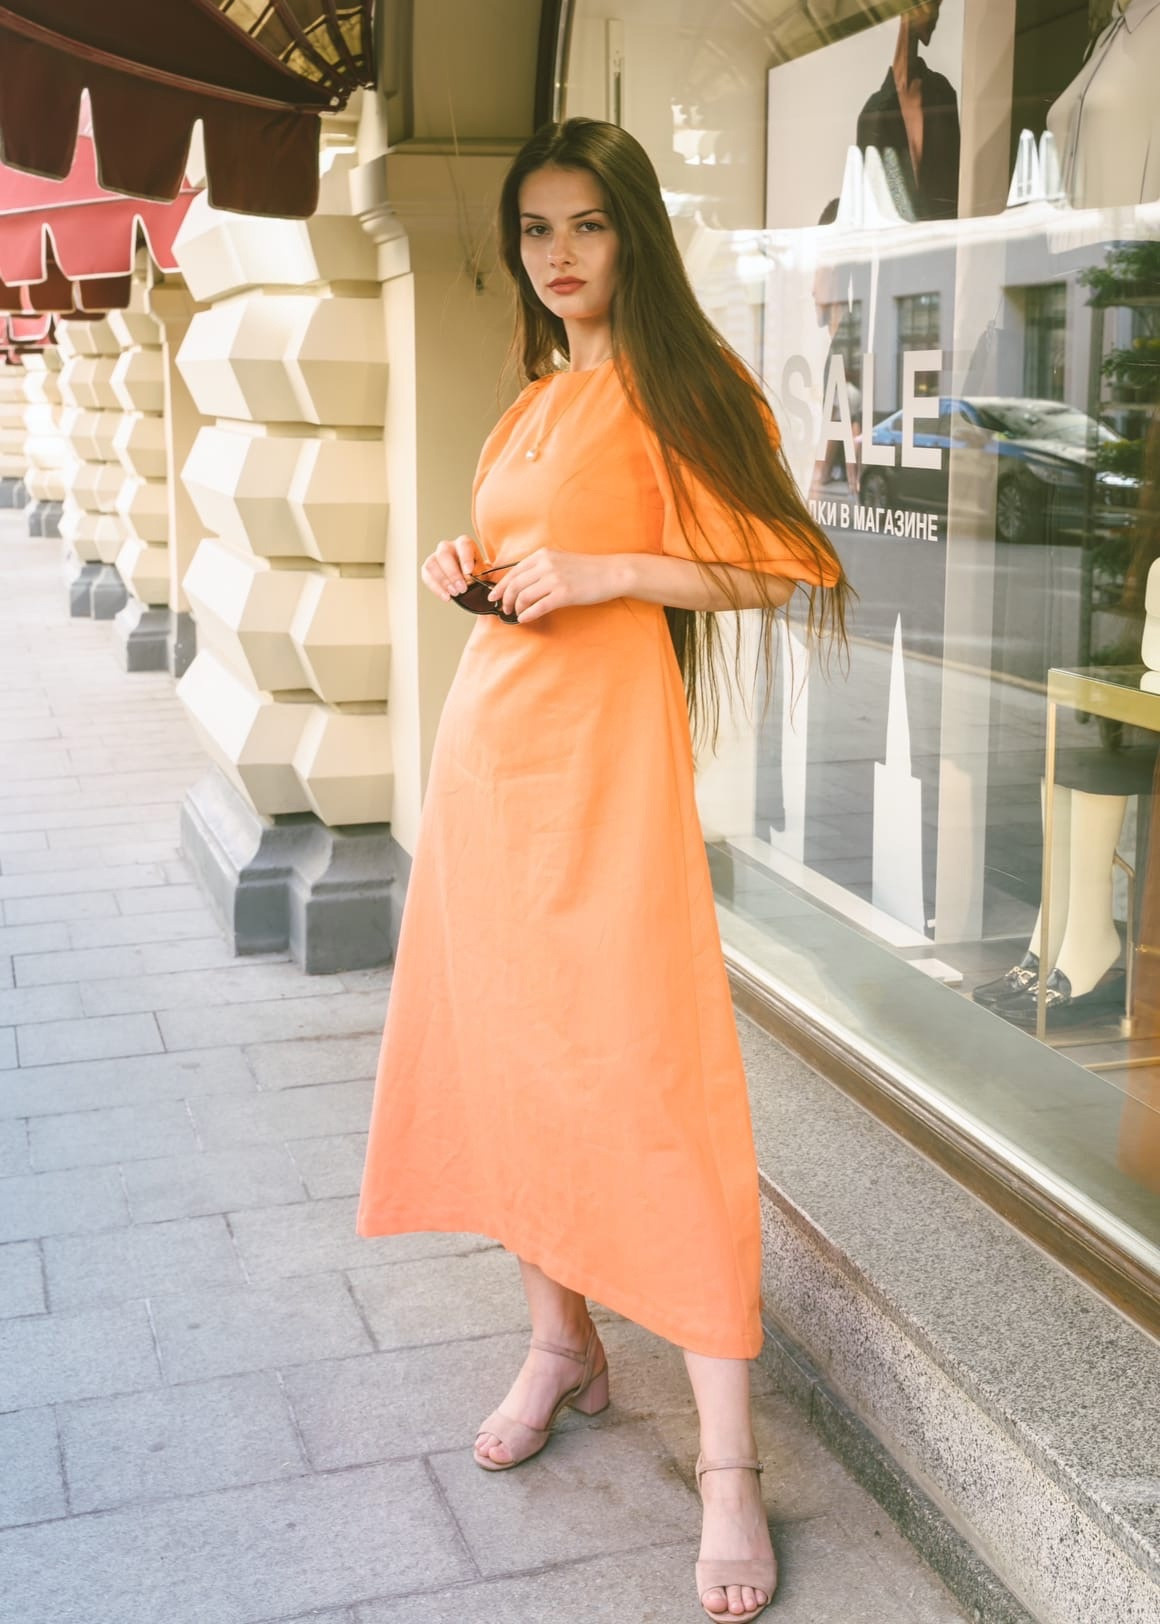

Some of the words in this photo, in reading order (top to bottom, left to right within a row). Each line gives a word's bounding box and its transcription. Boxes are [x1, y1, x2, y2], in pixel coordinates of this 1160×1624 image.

[781, 349, 943, 470] SALE
[808, 499, 837, 527] ДКИ
[840, 503, 850, 529] В
[853, 505, 938, 542] МАГАЗИНЕ
